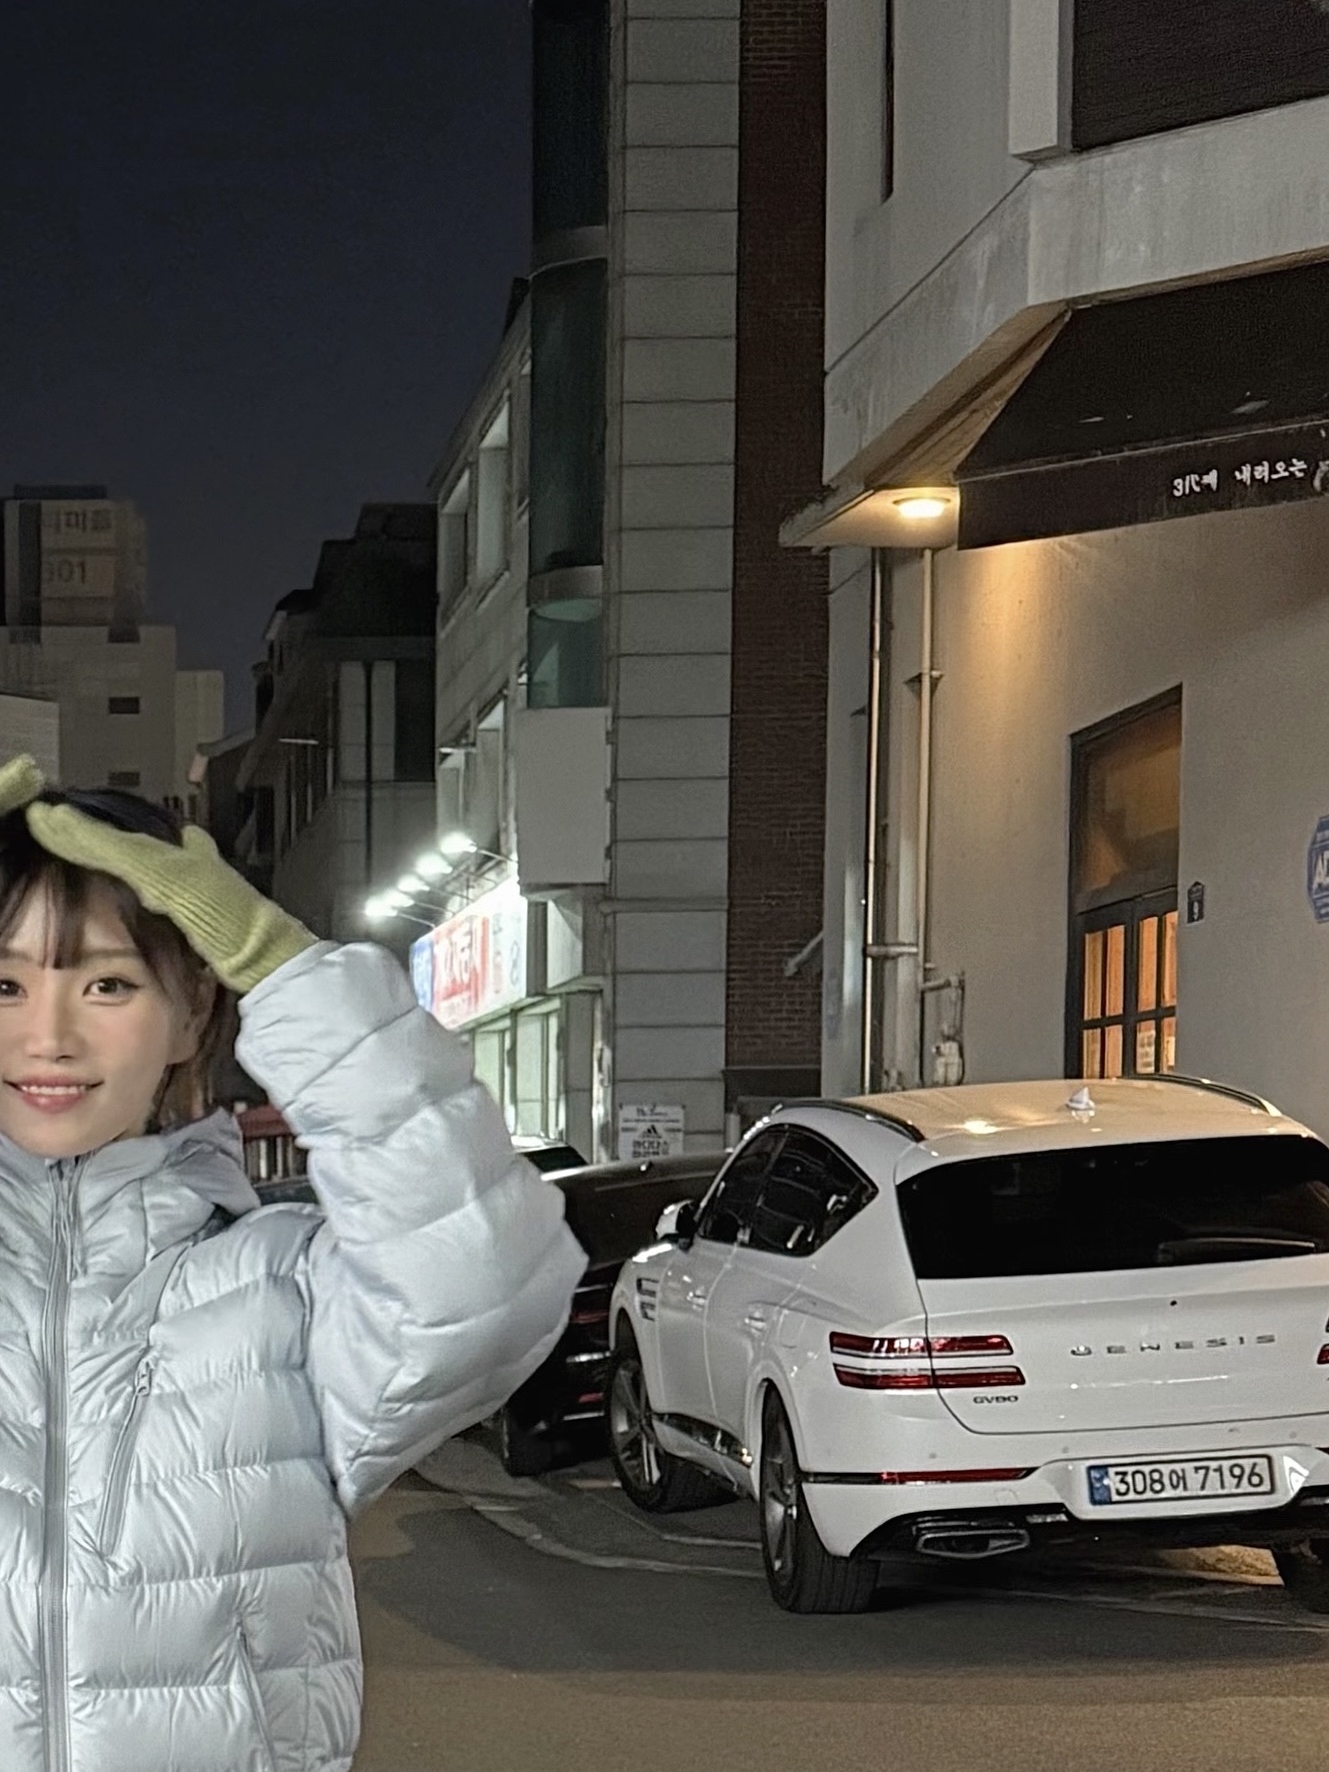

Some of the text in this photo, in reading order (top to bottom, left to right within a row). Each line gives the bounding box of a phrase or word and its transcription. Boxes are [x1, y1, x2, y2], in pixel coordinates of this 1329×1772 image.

[1234, 458, 1308, 486] 내려오는
[1070, 1334, 1275, 1357] GENESIS
[1113, 1462, 1265, 1498] 308어 7196
